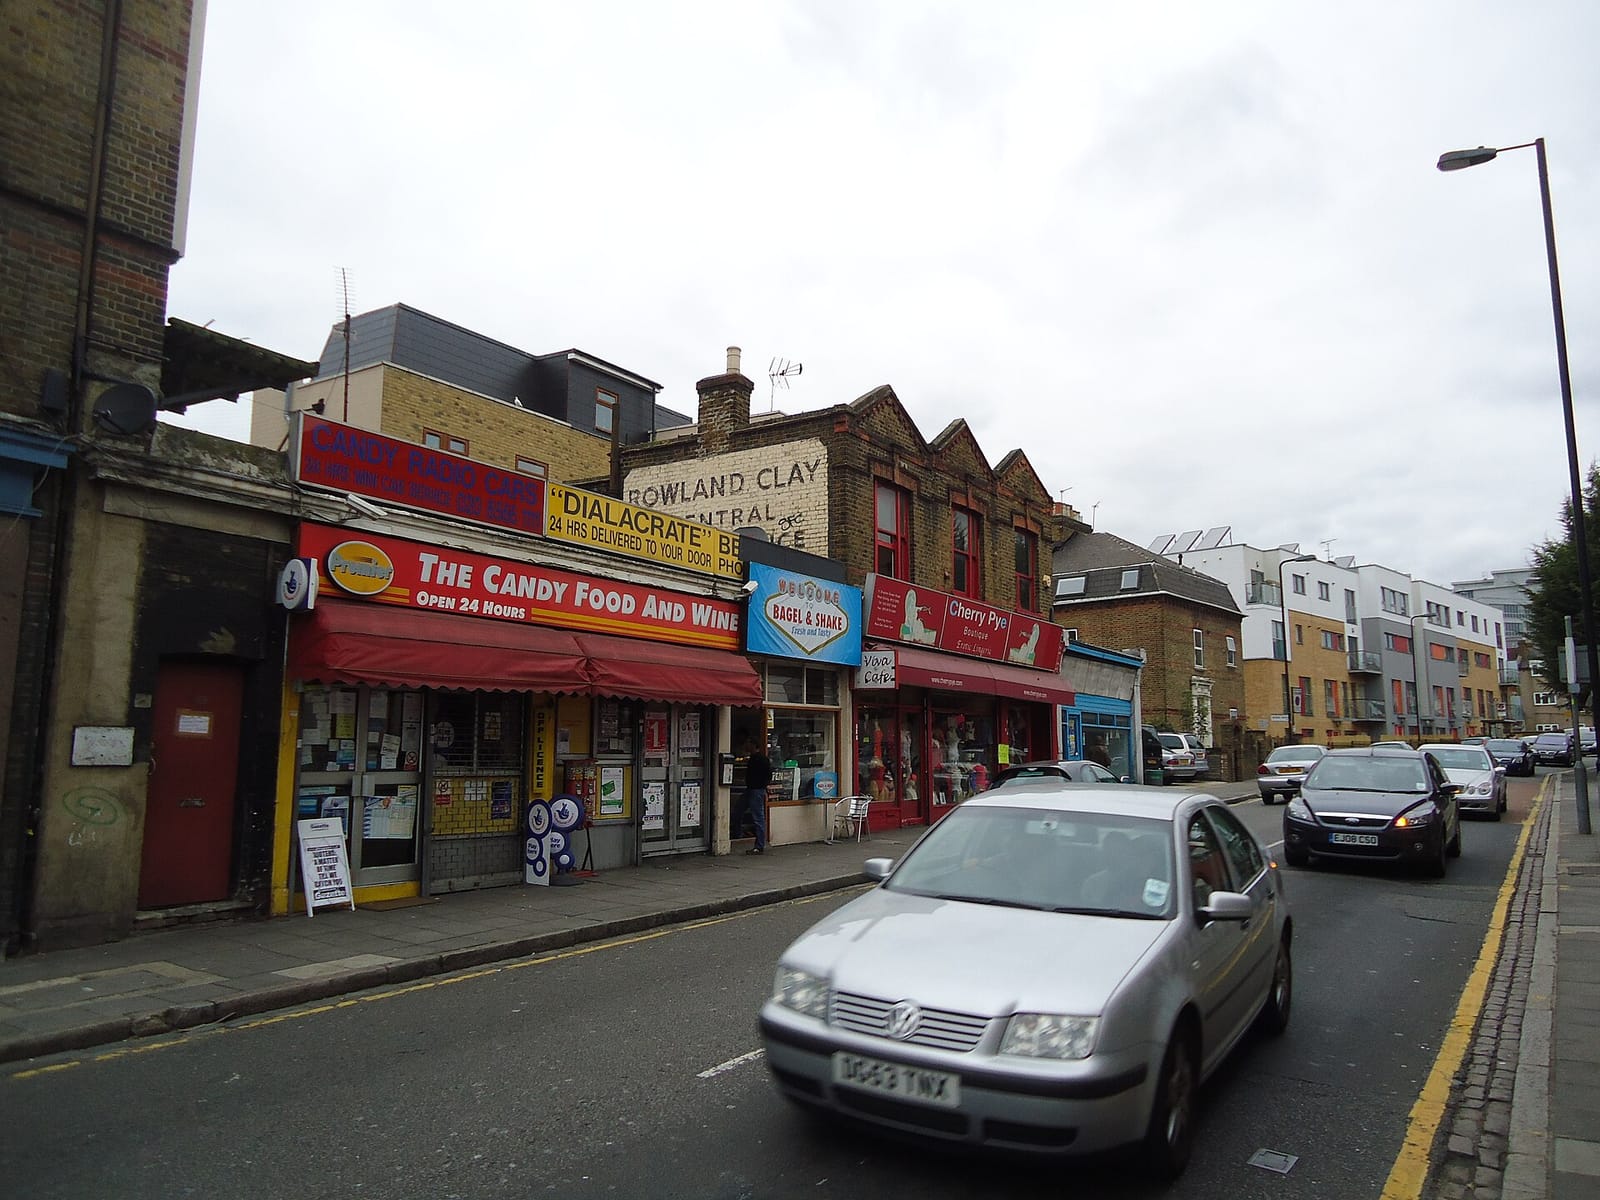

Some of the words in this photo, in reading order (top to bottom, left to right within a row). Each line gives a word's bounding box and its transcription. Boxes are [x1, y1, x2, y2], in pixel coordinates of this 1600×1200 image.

[312, 424, 399, 468] CANDY
[408, 450, 477, 489] RADIO
[484, 471, 539, 505] CARS
[628, 472, 745, 508] ROWLAND
[756, 458, 822, 491] CLAY
[549, 514, 563, 533] 24
[566, 518, 588, 540] HRS
[591, 525, 642, 551] DELIVERED
[645, 538, 657, 555] TO
[659, 541, 683, 562] YOUR
[687, 549, 713, 568] DOOR
[416, 590, 456, 610] OPEN
[458, 596, 480, 613] 24
[482, 600, 527, 620] HOURS
[418, 551, 474, 589] THE
[482, 563, 569, 605] CANDY
[574, 580, 636, 616] FOOD
[641, 594, 686, 624] AND
[691, 601, 740, 633] WINE
[778, 578, 841, 606] WELCOME
[772, 603, 803, 625] BAGEL
[805, 610, 813, 626] &
[815, 612, 843, 632] SHAKE
[949, 599, 986, 628] Cherry
[987, 611, 1008, 631] Pye
[963, 626, 990, 641] Boutique
[864, 655, 893, 669] Viva
[535, 736, 545, 789] LICENCE
